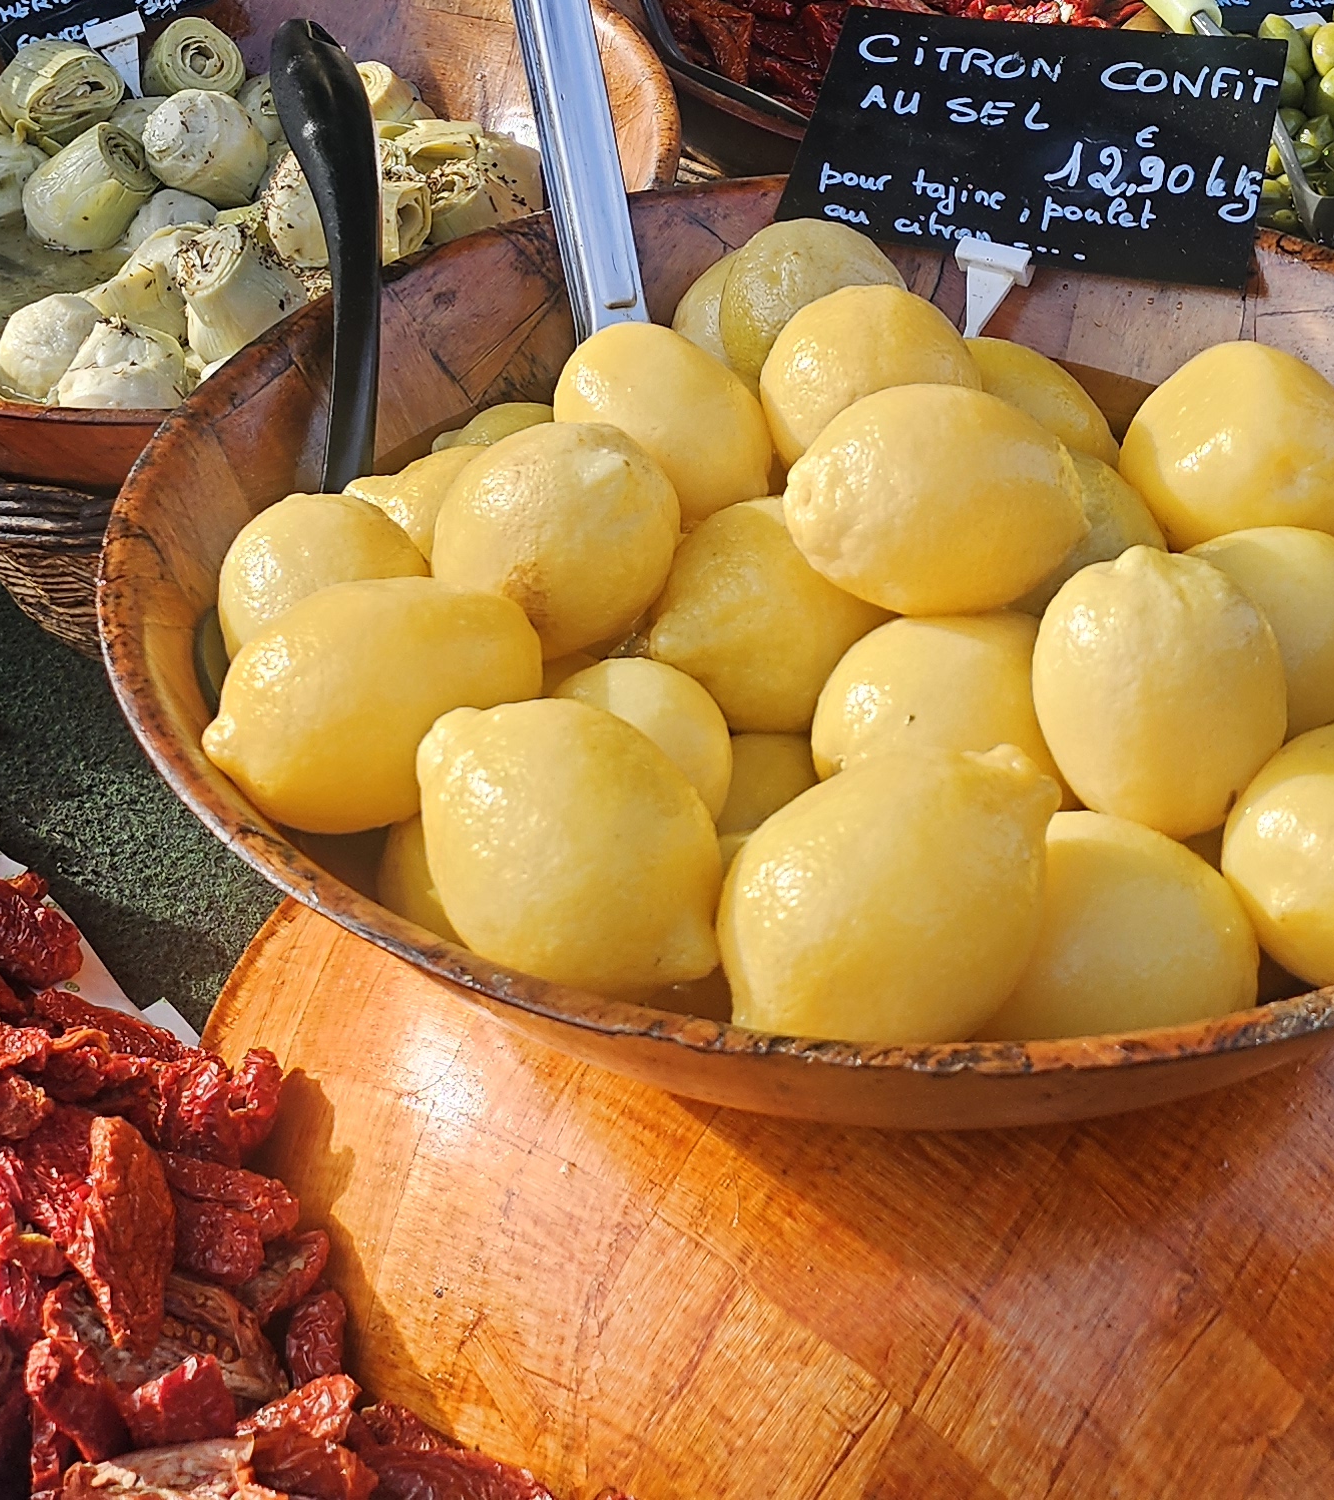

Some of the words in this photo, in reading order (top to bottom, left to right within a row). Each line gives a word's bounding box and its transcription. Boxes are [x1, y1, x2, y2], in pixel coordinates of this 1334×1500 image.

[859, 84, 921, 116] AU
[949, 96, 1050, 131] SEL
[818, 161, 892, 193] pour
[1040, 195, 1158, 232] poulet
[822, 202, 871, 226] au
[893, 216, 992, 243] citron
